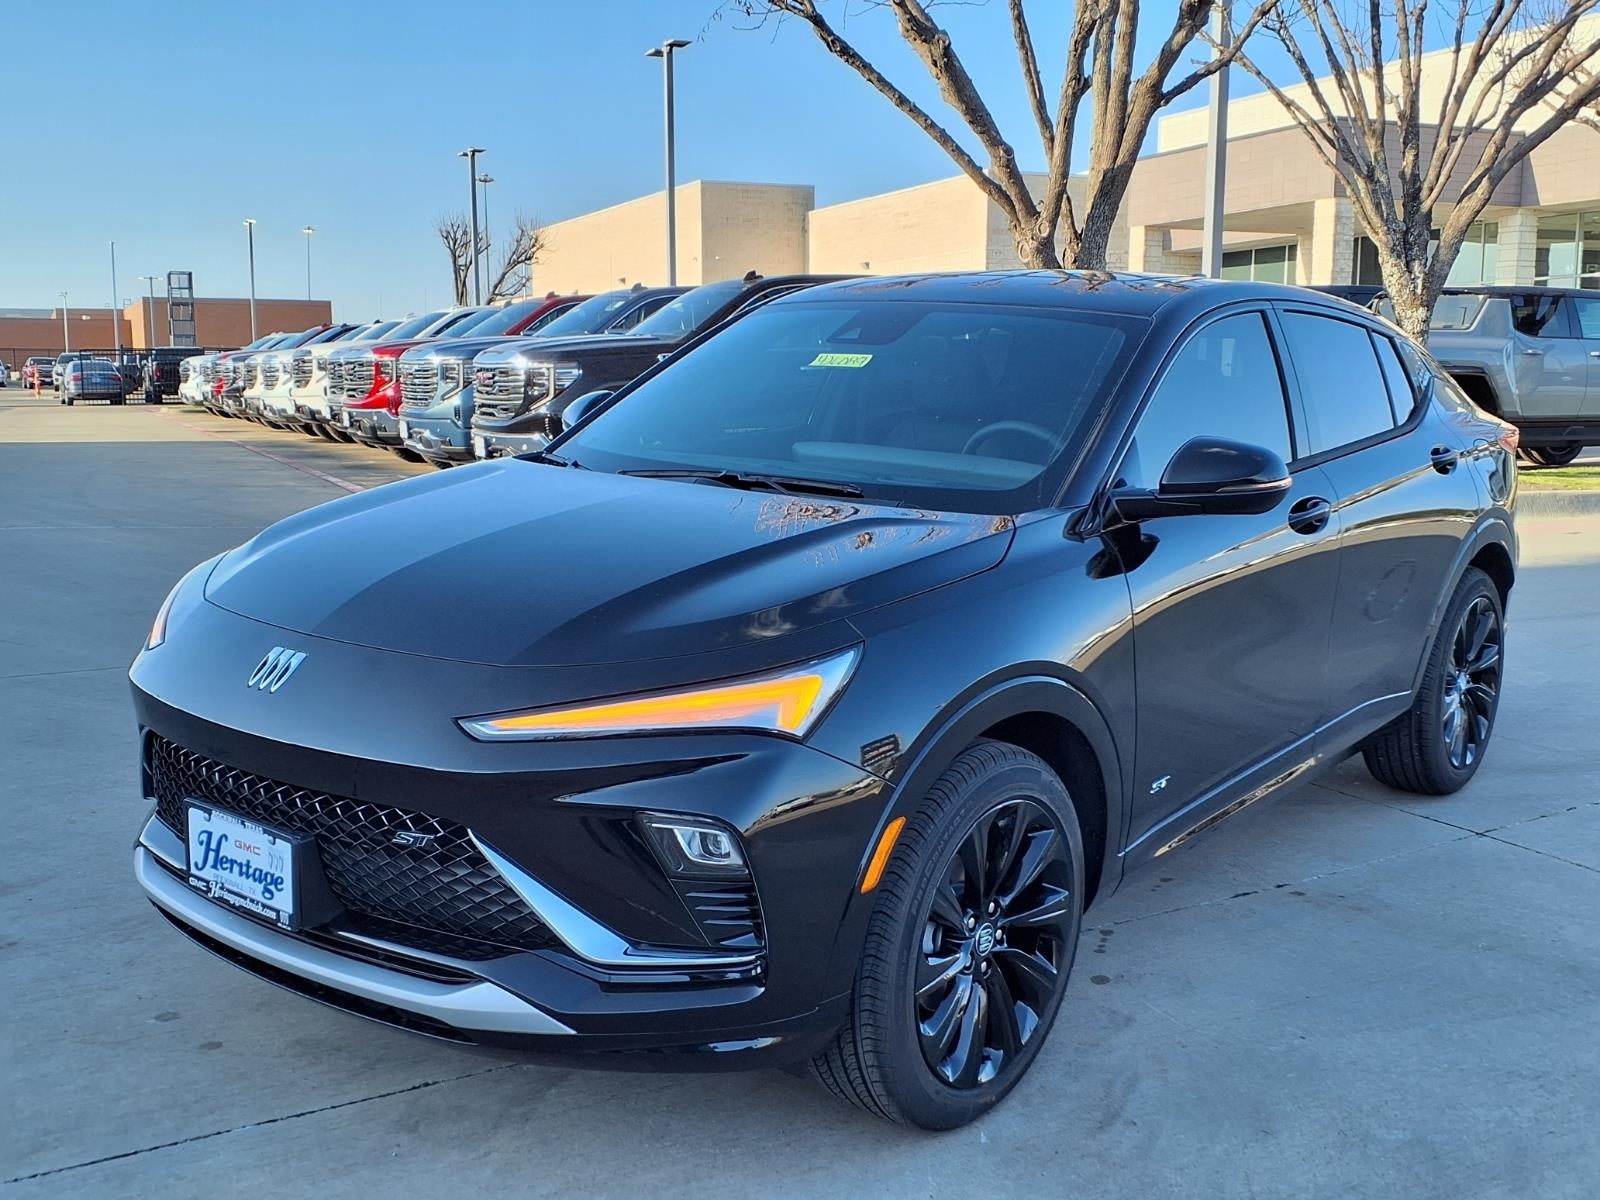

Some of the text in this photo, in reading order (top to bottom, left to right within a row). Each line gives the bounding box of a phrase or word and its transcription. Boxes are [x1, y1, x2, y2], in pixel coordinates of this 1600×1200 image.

[234, 839, 261, 856] GMC
[392, 831, 435, 848] ST
[194, 829, 285, 901] Heritage
[188, 876, 208, 891] GMC
